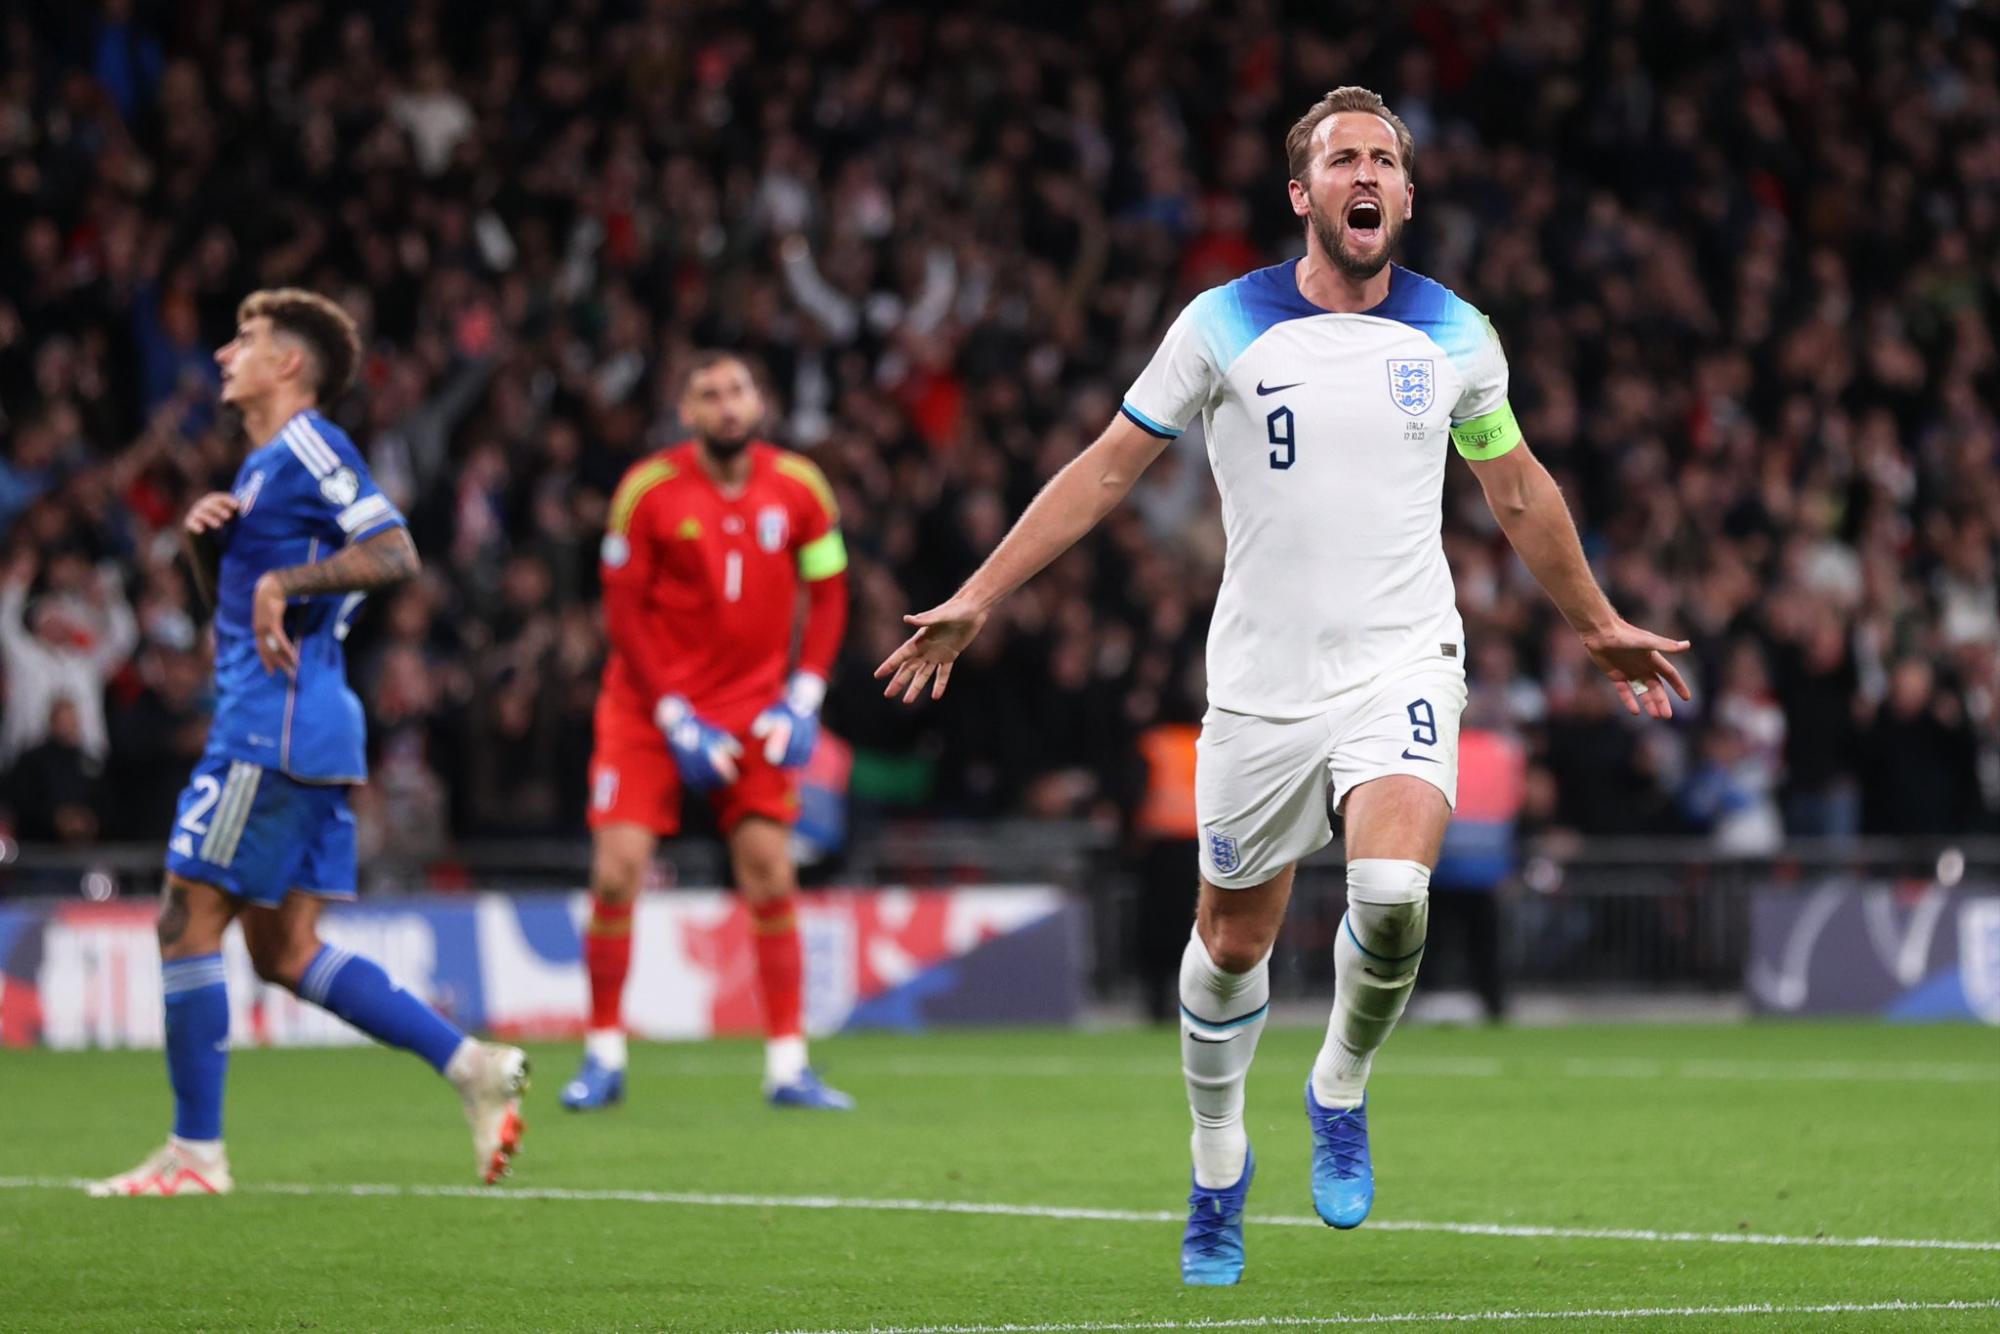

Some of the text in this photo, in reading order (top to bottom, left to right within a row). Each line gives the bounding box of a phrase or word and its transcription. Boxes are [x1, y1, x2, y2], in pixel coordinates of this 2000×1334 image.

[1267, 405, 1296, 470] 9
[1459, 425, 1503, 444] RESPECT
[724, 550, 743, 602] 1
[1406, 698, 1438, 746] 9
[179, 773, 221, 836] 2
